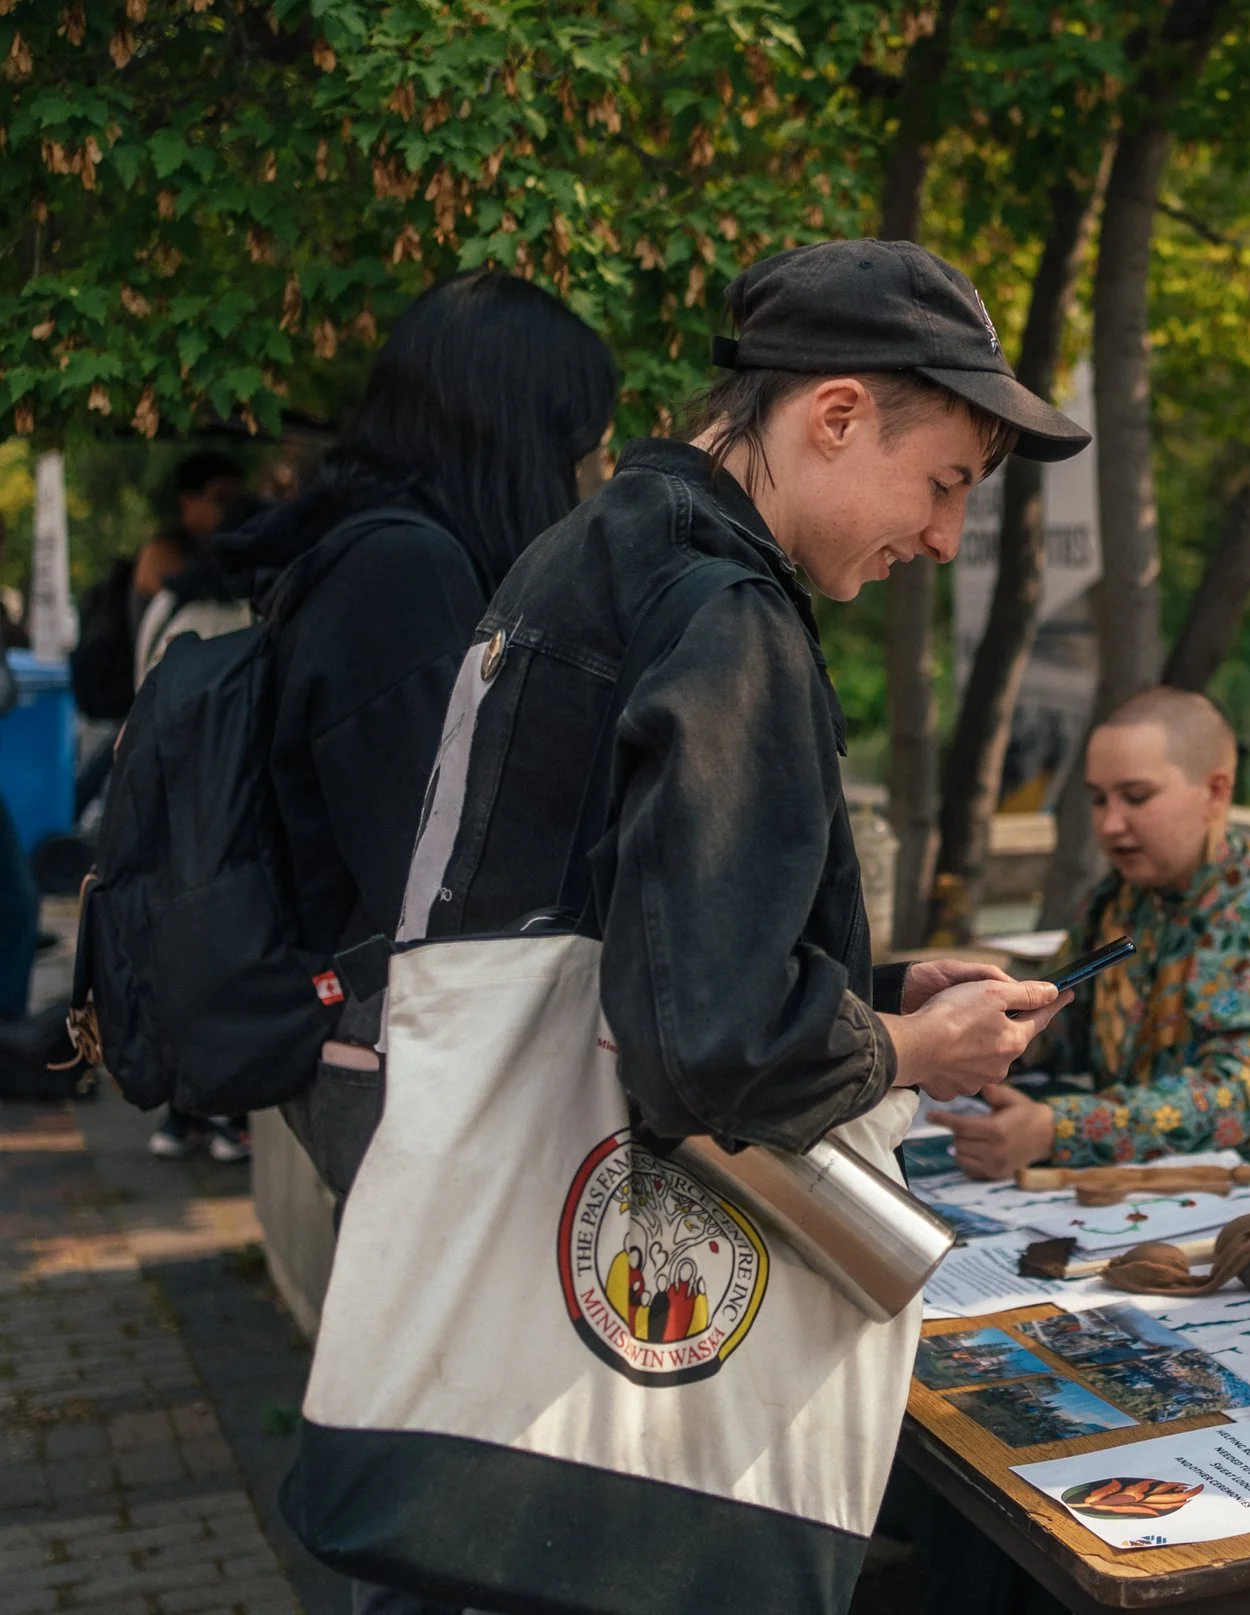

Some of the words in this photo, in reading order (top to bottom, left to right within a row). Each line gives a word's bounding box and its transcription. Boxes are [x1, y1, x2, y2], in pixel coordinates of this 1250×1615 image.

[581, 1187, 605, 1226] PAS
[577, 1231, 593, 1277] THE
[712, 1209, 754, 1281] CENTRE
[722, 1282, 752, 1323] INC
[1214, 1446, 1244, 1467] NEEDED
[1215, 1429, 1246, 1453] HELPING
[1174, 1456, 1193, 1470] AND
[1188, 1467, 1215, 1482] OTHER
[1209, 1461, 1236, 1479] SWEAT
